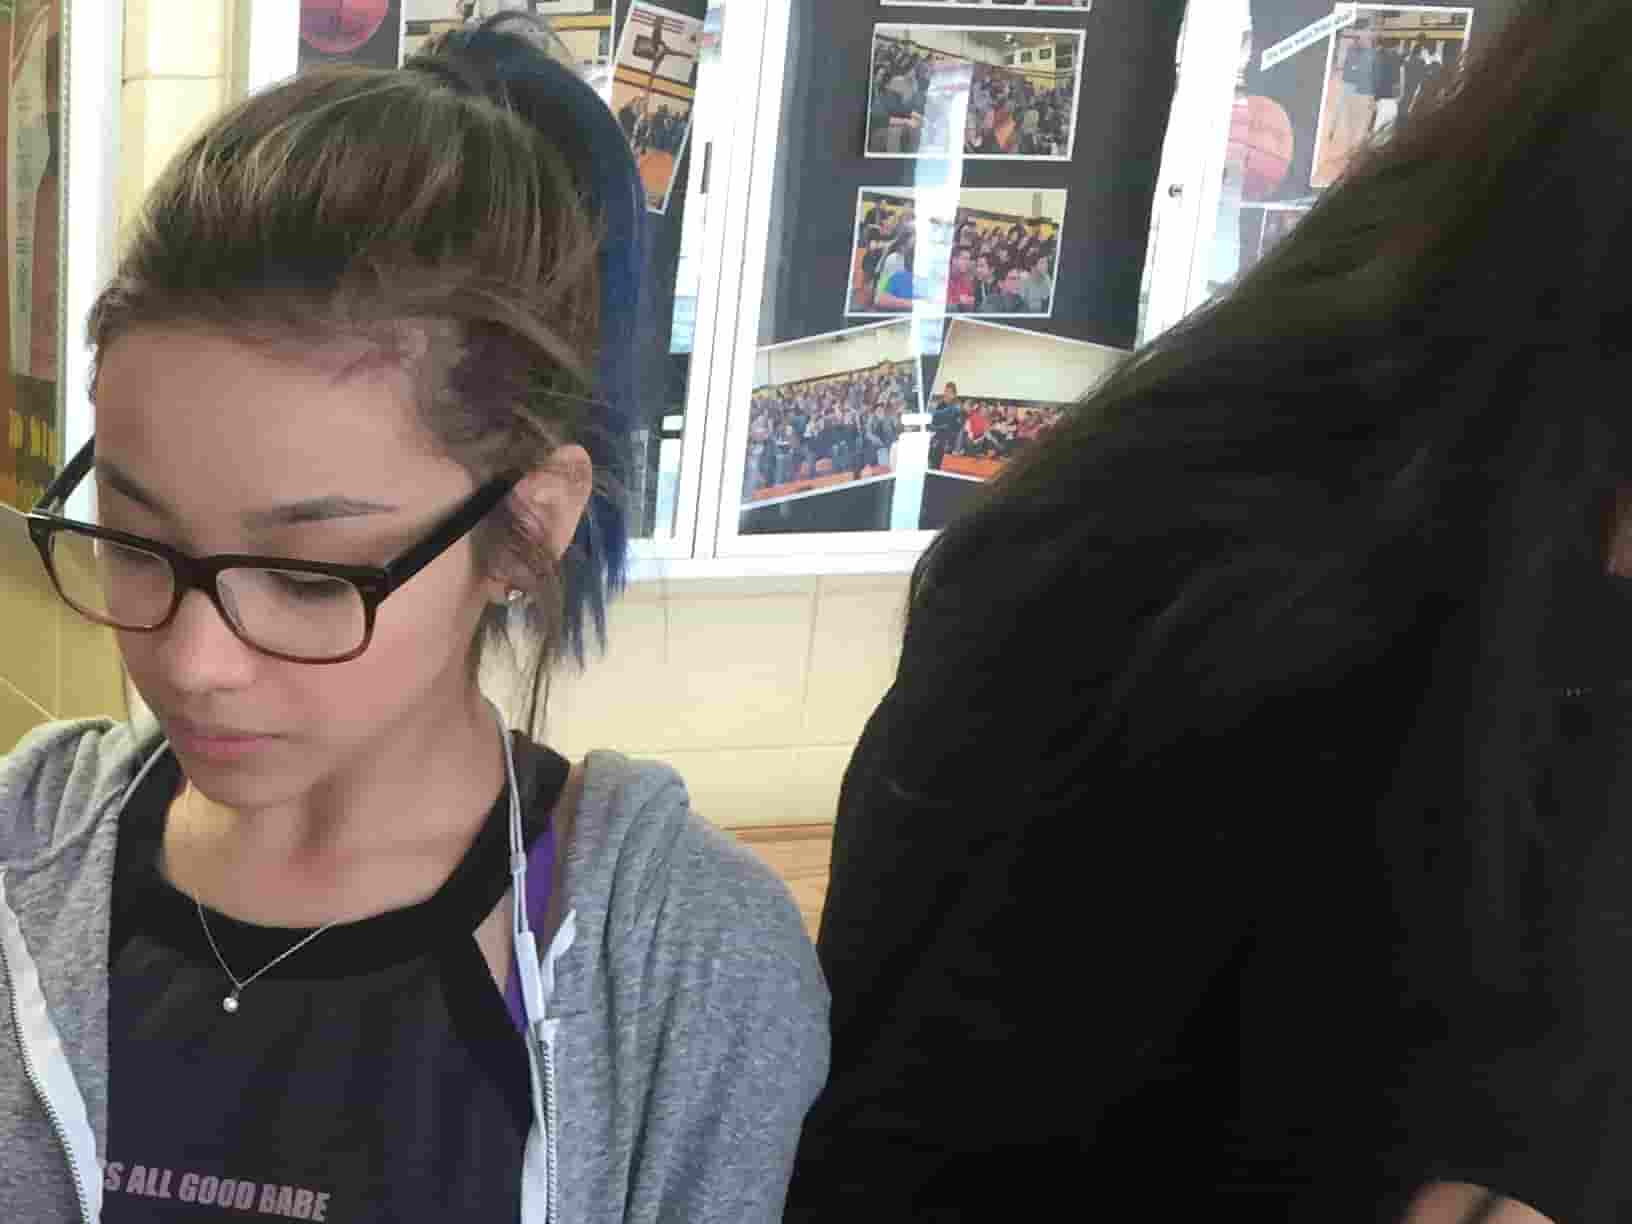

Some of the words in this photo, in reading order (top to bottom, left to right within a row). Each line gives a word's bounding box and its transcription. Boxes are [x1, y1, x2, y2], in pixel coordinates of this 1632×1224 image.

[126, 1165, 172, 1198] ALL
[179, 1172, 256, 1210] GOOD
[259, 1184, 331, 1223] BABE
